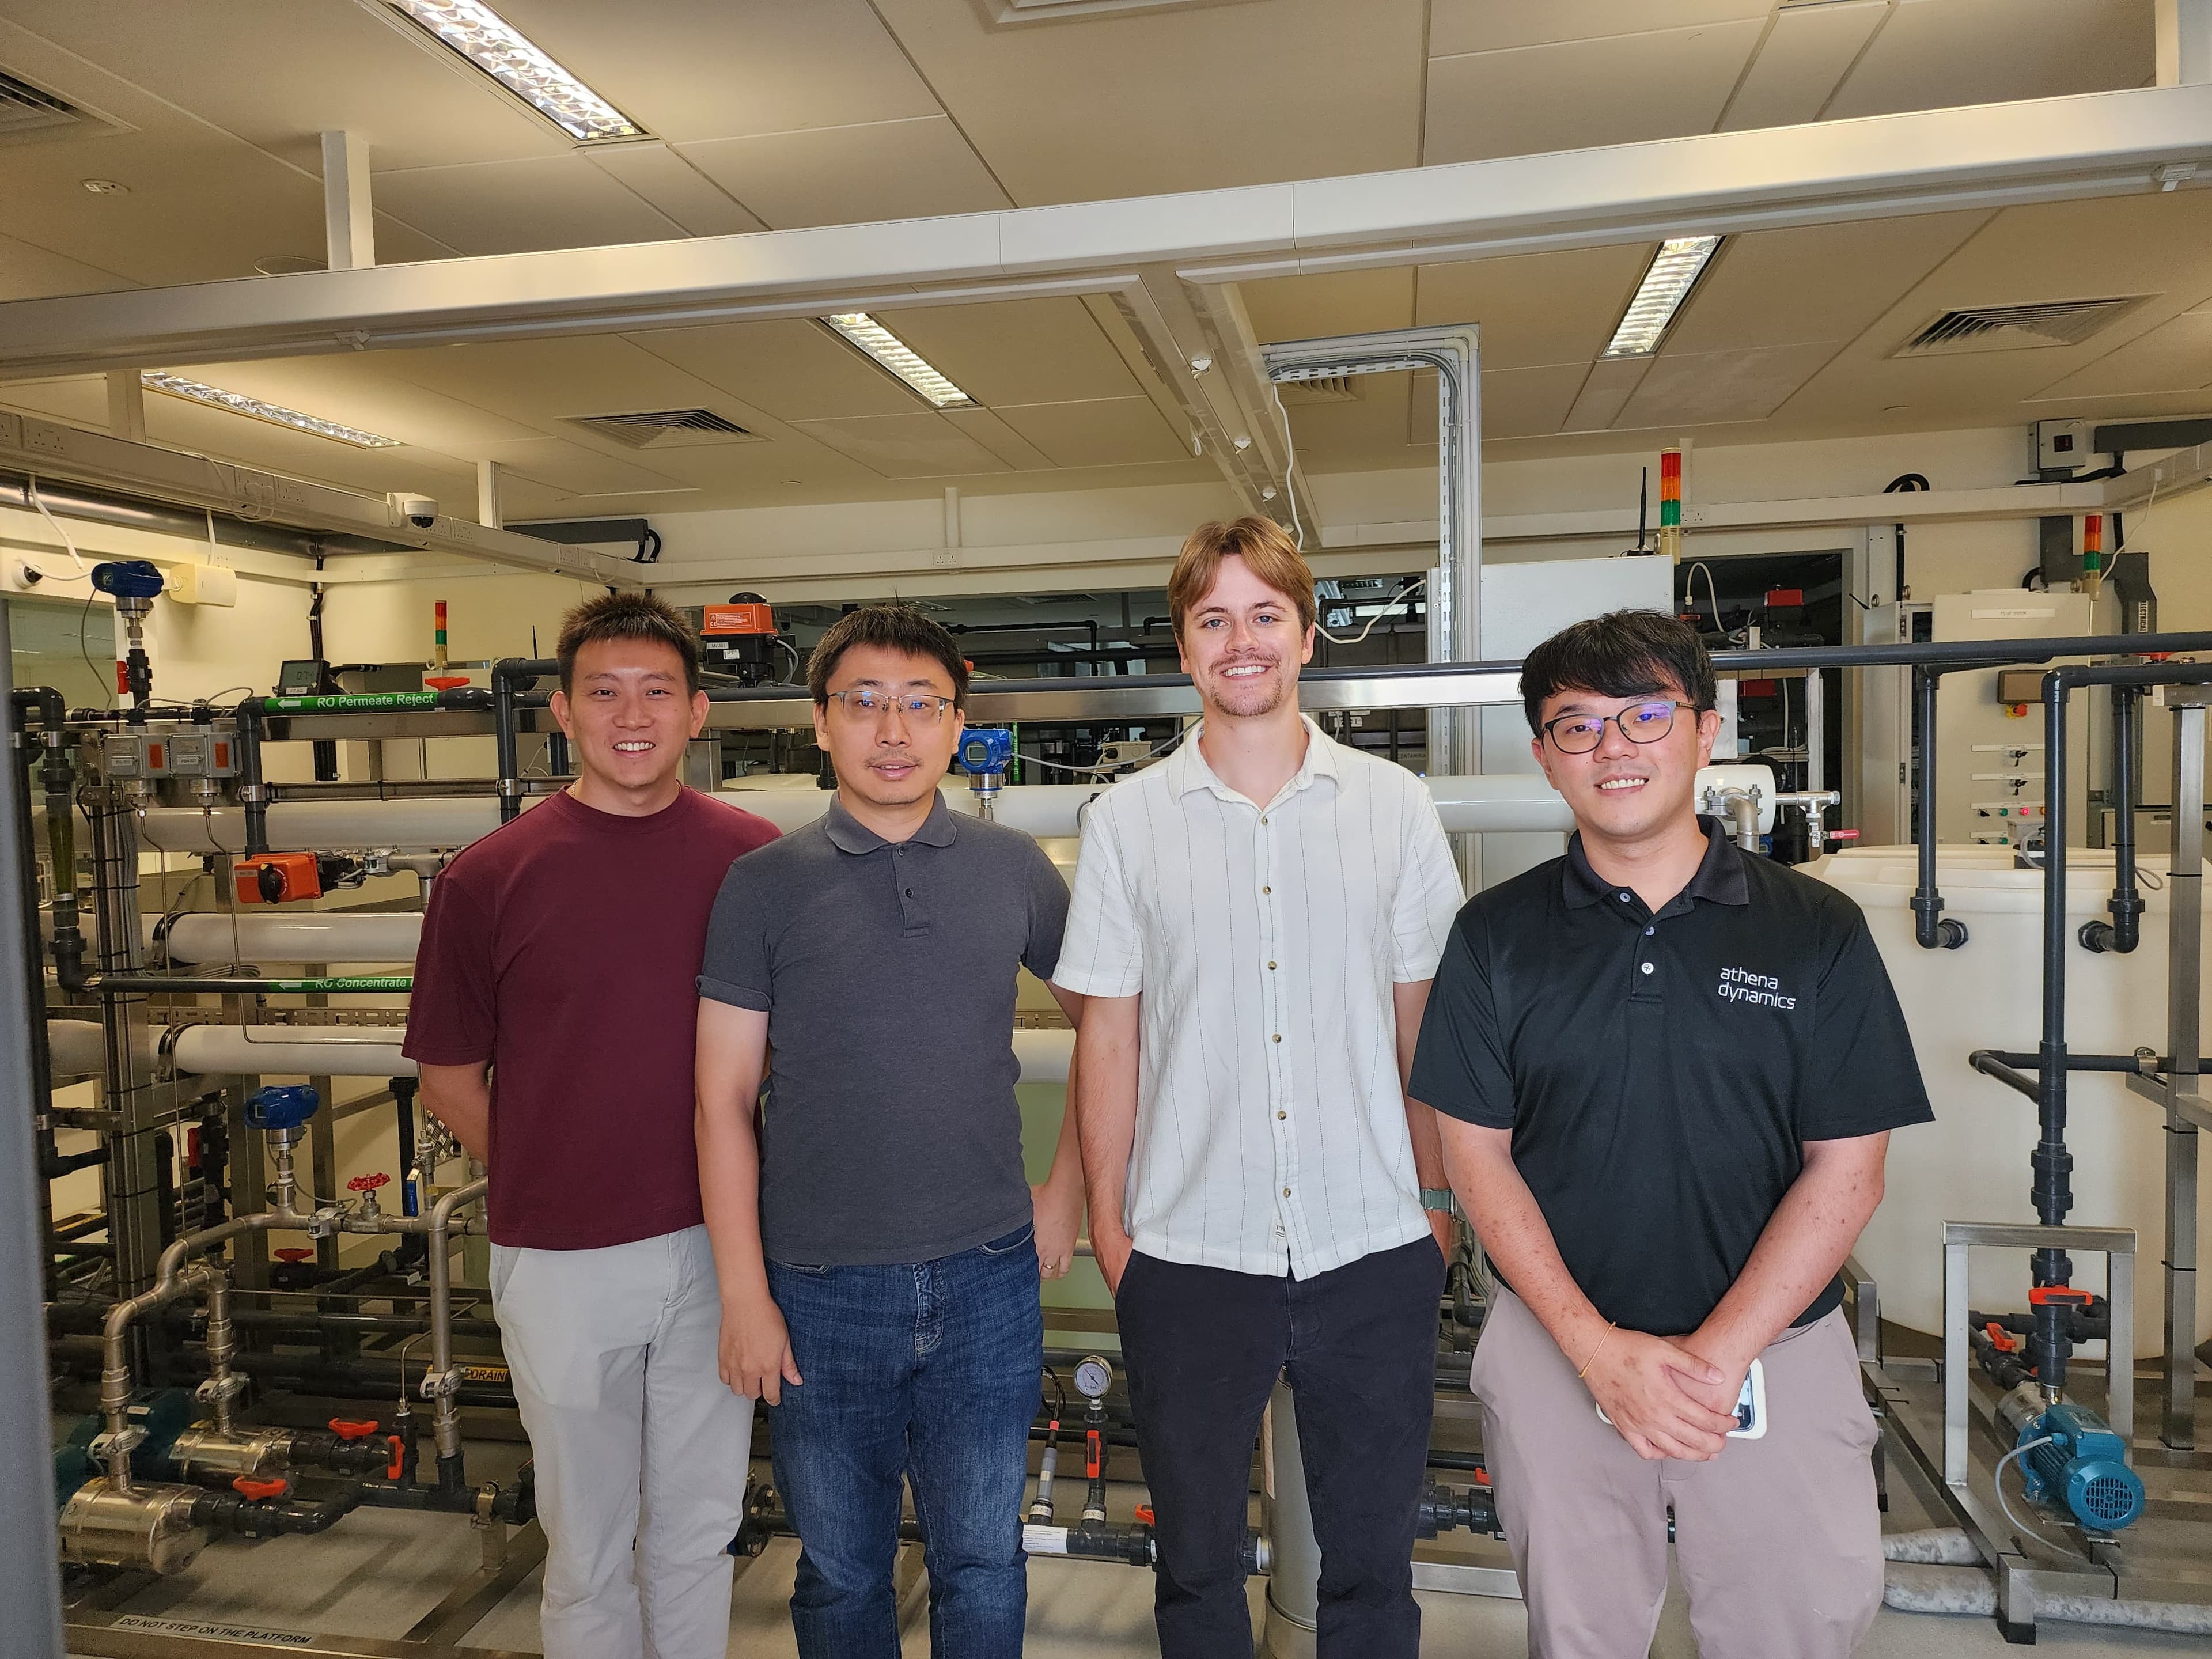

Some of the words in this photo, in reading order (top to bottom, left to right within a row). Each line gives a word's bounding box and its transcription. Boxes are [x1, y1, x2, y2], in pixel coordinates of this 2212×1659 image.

[317, 698, 335, 708] RO
[339, 695, 393, 707] Permeate
[397, 694, 434, 706] Reject
[336, 978, 407, 988] Concentrate
[1720, 967, 1778, 990] athena
[1718, 982, 1796, 1010] dynamics
[471, 1369, 507, 1381] DRAIN
[139, 1620, 167, 1628] NOT
[166, 1623, 199, 1632] STEP
[198, 1626, 218, 1634] ON
[219, 1628, 246, 1637] THE
[243, 1631, 312, 1644] PLATFORM
